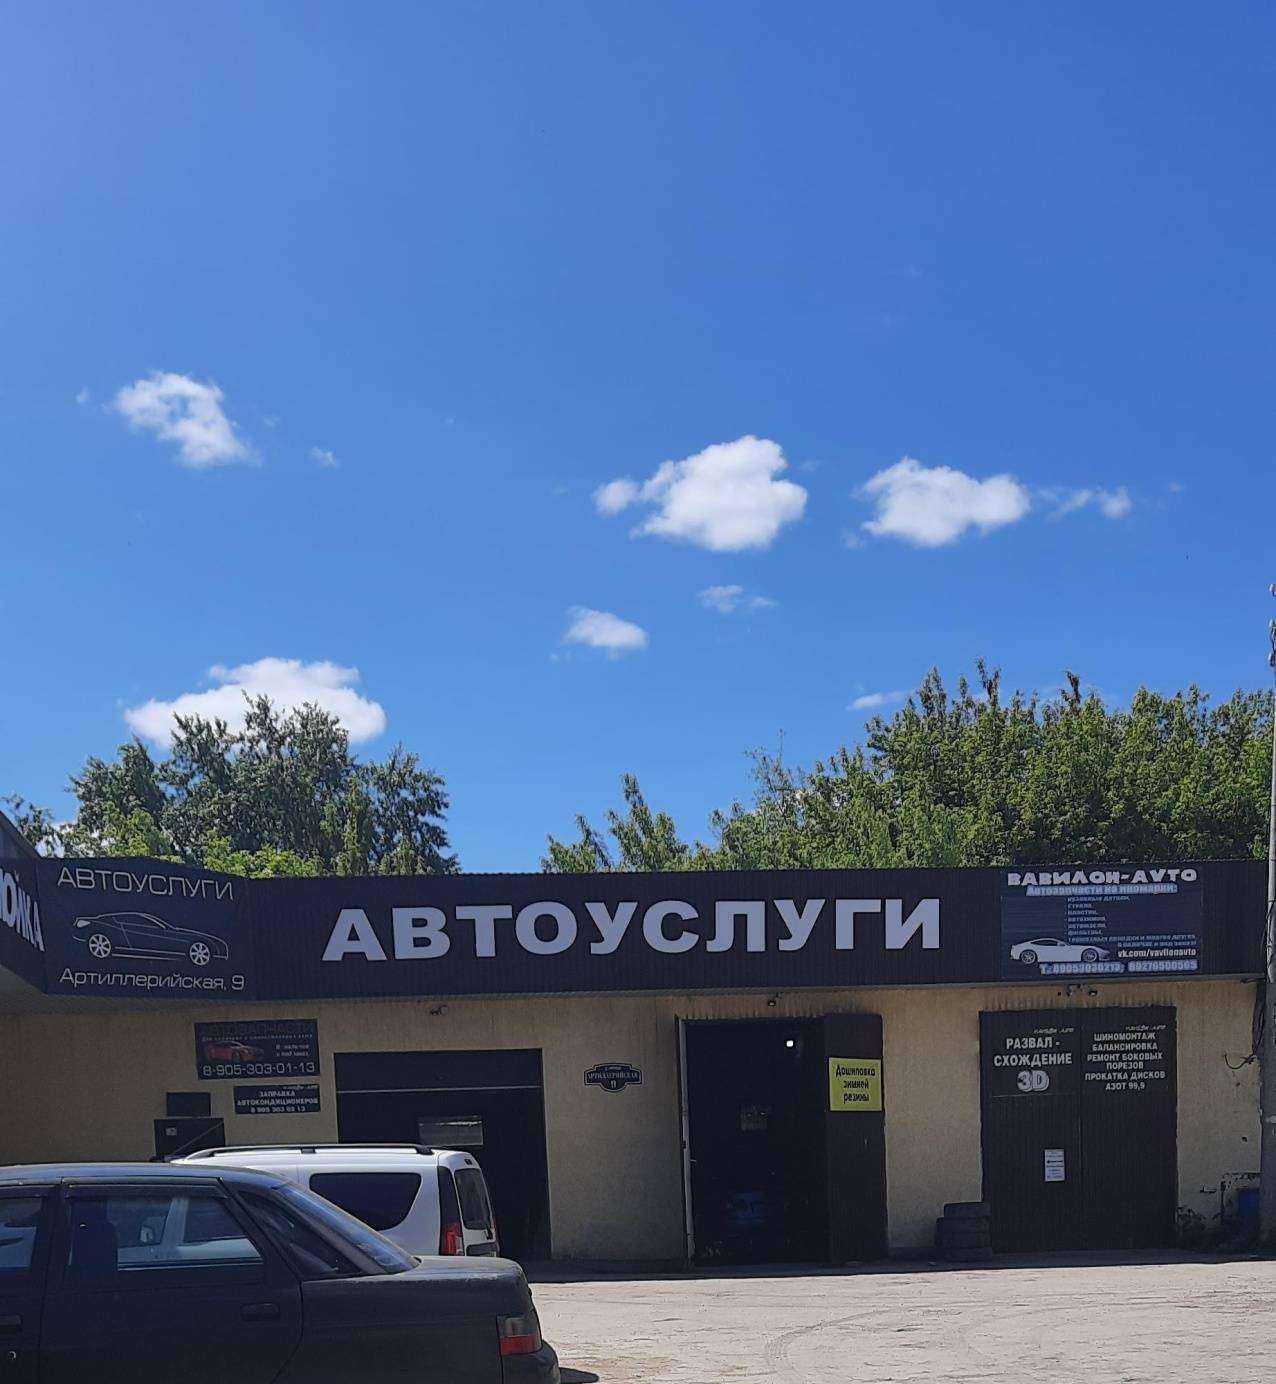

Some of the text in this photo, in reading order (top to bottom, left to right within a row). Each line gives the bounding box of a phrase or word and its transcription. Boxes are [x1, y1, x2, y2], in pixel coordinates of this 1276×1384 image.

[57, 866, 234, 900] АВТОУСЛУГИ
[0, 866, 46, 952] ОЙКА
[321, 898, 941, 963] АВТОУСЛУГИ
[231, 975, 245, 991] 9
[1006, 1037, 1053, 1050] РАЗВАЛ
[1093, 1032, 1156, 1042] ШИНОМОНТАЖ
[1092, 1043, 1158, 1051] БАЛАНСИРОВКА
[993, 1053, 1072, 1068] СХОЖДЕНИЕ
[1087, 1052, 1163, 1062] РЕМОНТ БОКОВЫХ
[202, 1061, 316, 1077] 8-905-303-01-13
[835, 1064, 876, 1077] Дошиповка
[1106, 1062, 1144, 1070] ПОРЕЗОВ
[1016, 1070, 1050, 1092] 3D
[1084, 1071, 1166, 1081] ПРОКАТКА ДИСКОВ
[843, 1078, 869, 1089] зимней
[1105, 1081, 1146, 1091] АЗОТ 99,9
